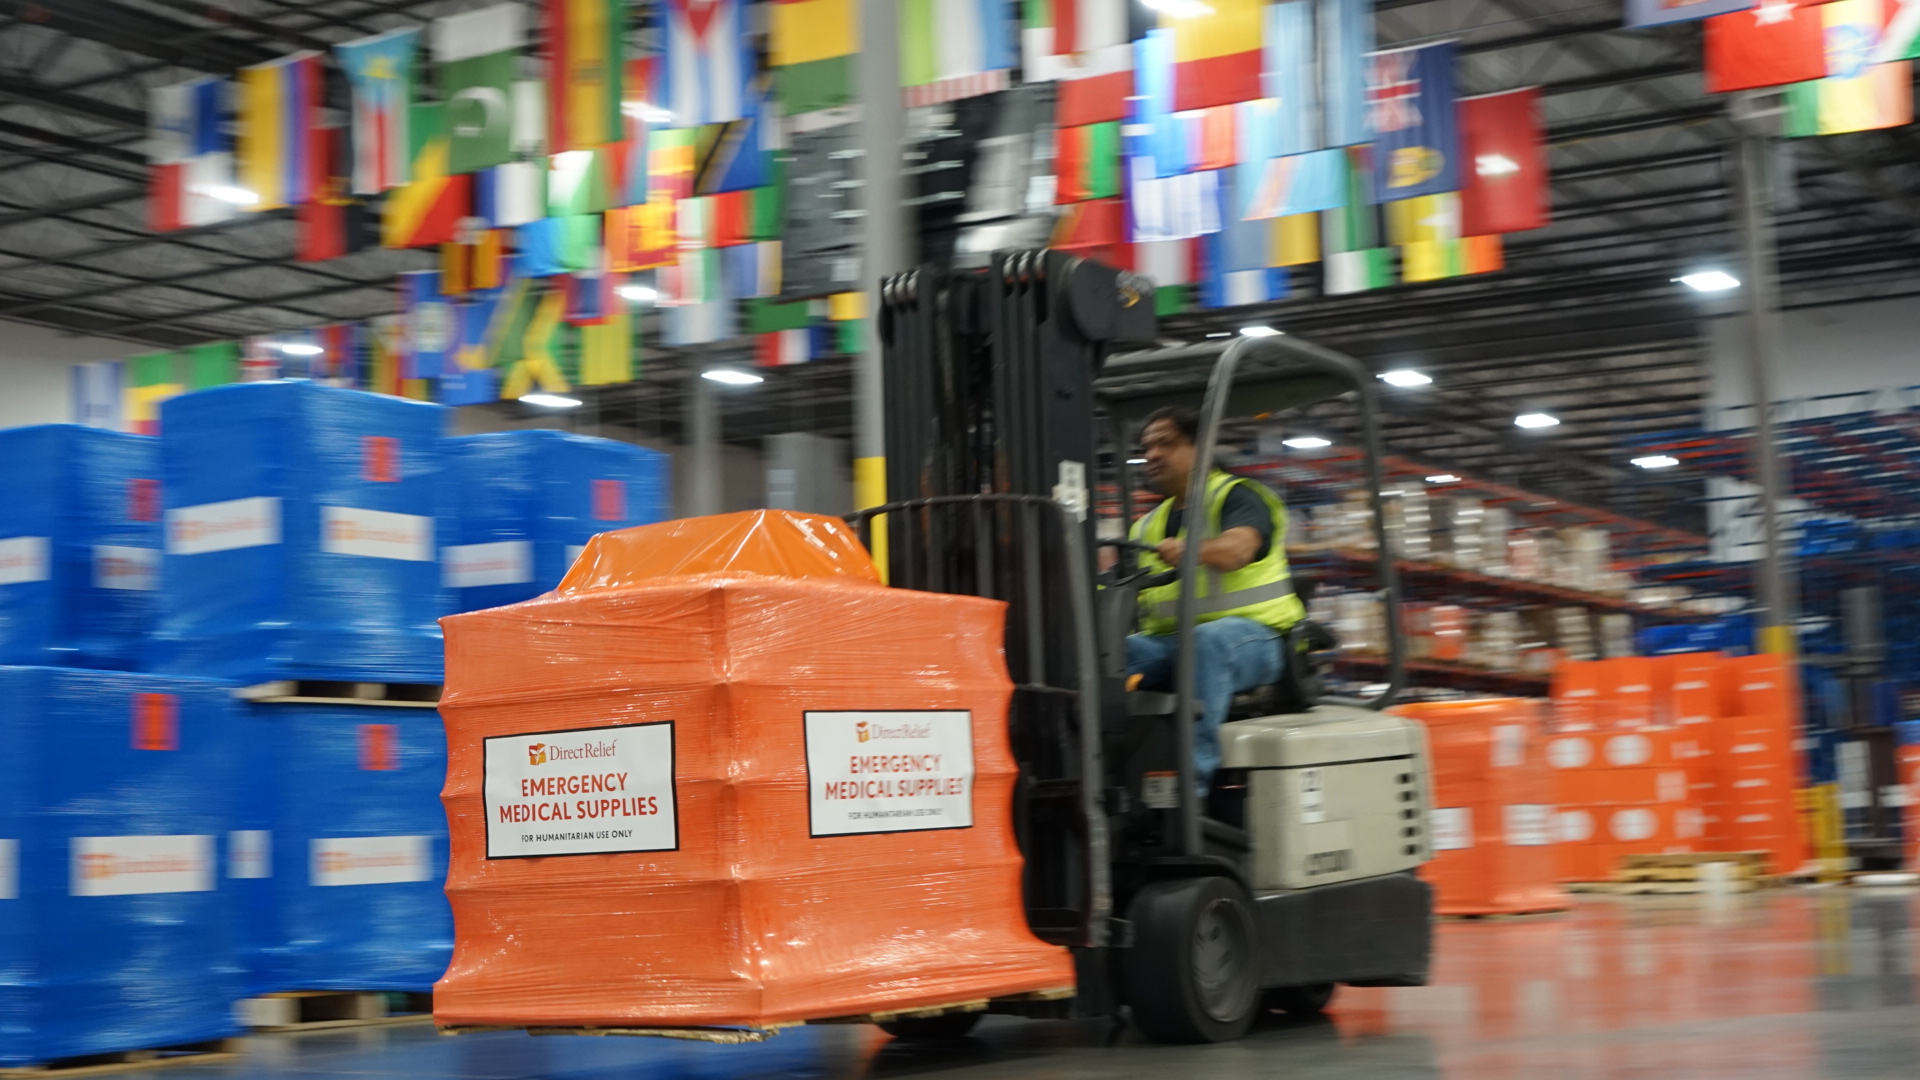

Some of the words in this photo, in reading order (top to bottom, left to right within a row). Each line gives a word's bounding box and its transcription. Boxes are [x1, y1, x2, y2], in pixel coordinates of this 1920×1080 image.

[850, 755, 942, 774] EMERGENCY
[521, 772, 628, 797] EMERGENCY
[825, 780, 894, 800] MEDICAL
[897, 777, 964, 797] SUPPLIES
[499, 801, 572, 823] MEDICAL
[576, 796, 659, 819] SUPPLIES
[848, 812, 862, 820] FOR
[521, 834, 534, 843] FOR
[536, 830, 594, 842] HUMANITARIAN
[596, 830, 609, 839] USE
[611, 829, 633, 839] ONLY
